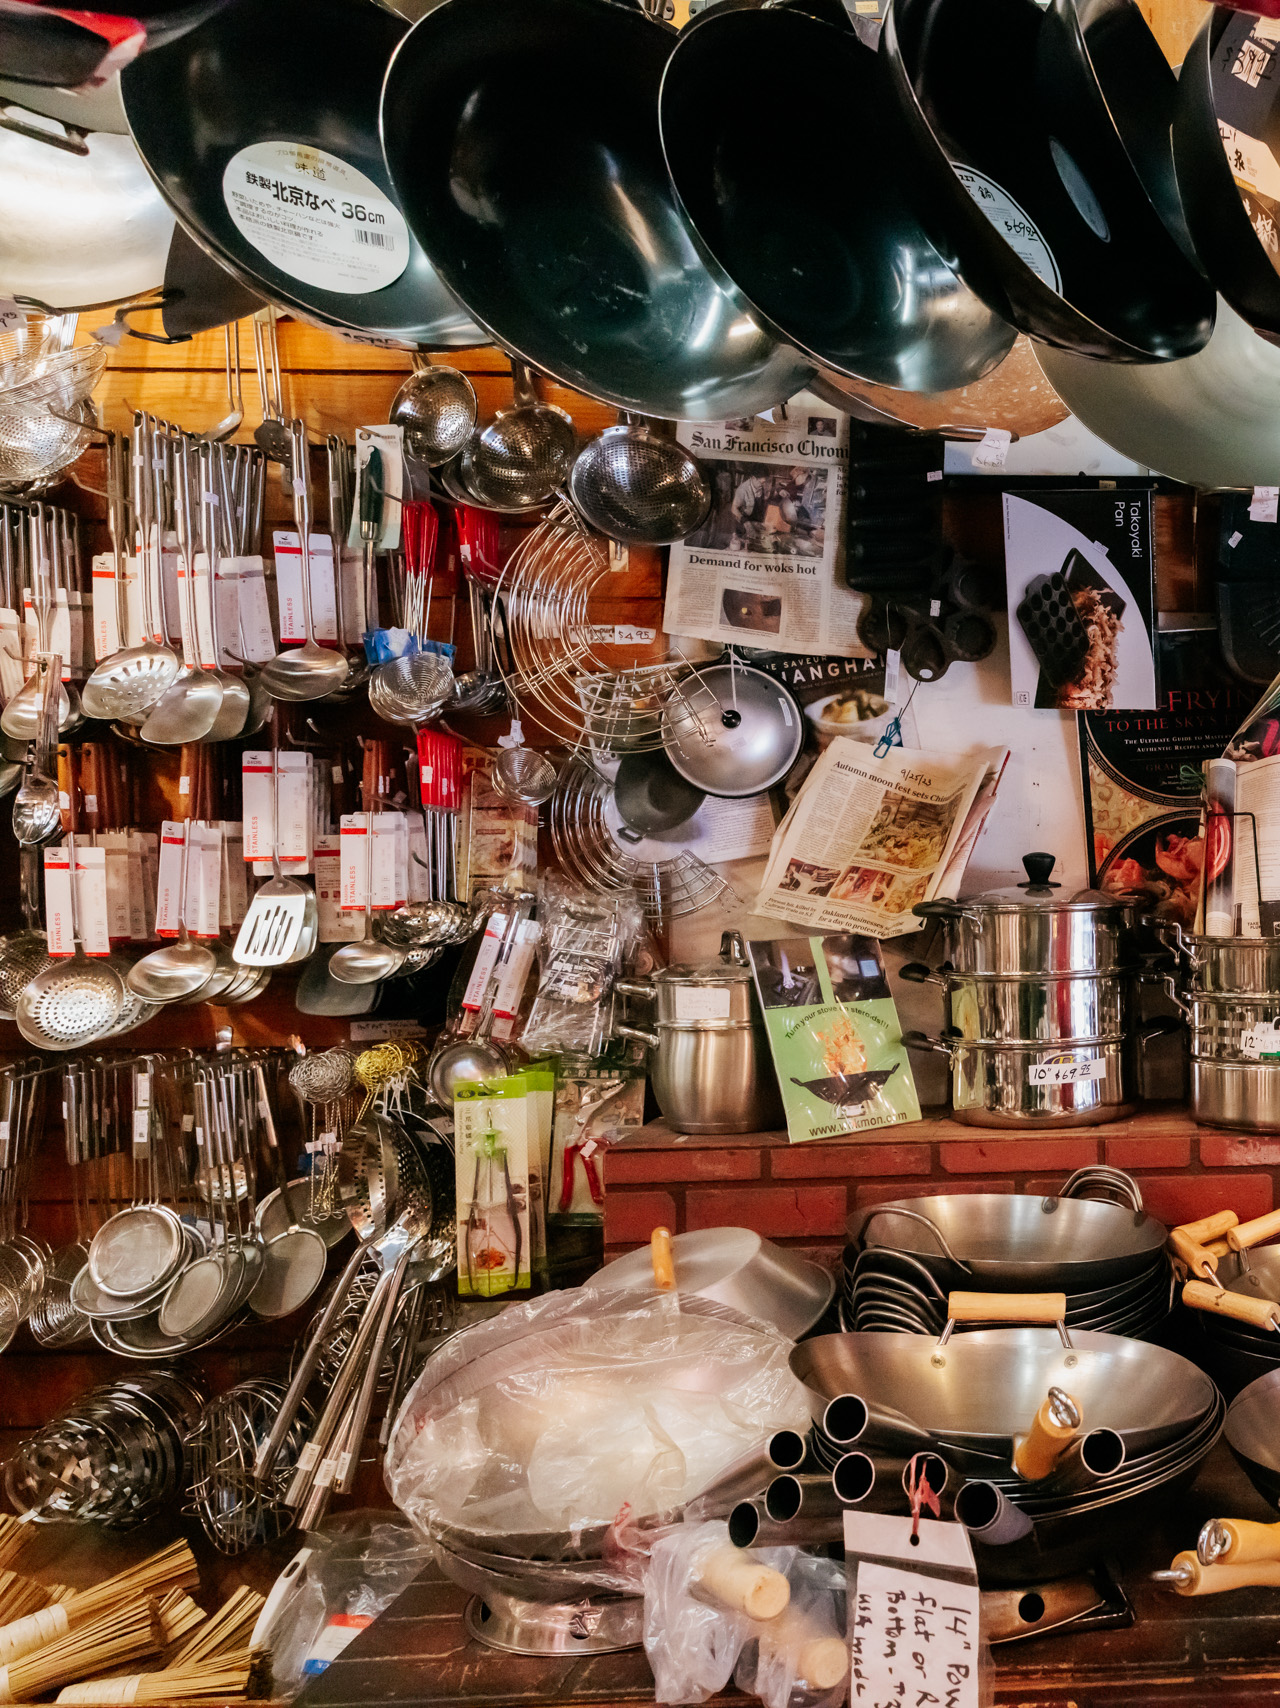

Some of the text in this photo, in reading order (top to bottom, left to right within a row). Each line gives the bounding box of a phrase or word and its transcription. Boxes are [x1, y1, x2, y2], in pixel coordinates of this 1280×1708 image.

[690, 431, 721, 449] San
[722, 434, 794, 454] Francisco
[1114, 501, 1126, 527] Pan
[1129, 500, 1142, 558] Takoyaki
[689, 554, 816, 575] Demand for woks hot
[783, 655, 827, 668] SAVEUR
[1105, 720, 1130, 732] TO
[1134, 718, 1169, 731] THE
[833, 760, 868, 778] Autumn
[868, 773, 894, 788] moon
[894, 782, 911, 795] fest
[911, 790, 929, 800] sets
[900, 768, 932, 787] 9/25/23
[822, 909, 884, 929] Oakland businesses
[832, 918, 844, 926] day
[852, 924, 876, 934] protest
[785, 1023, 801, 1040] Turn
[800, 1011, 816, 1026] your
[817, 1006, 838, 1015] stove
[911, 1592, 937, 1679] flat or
